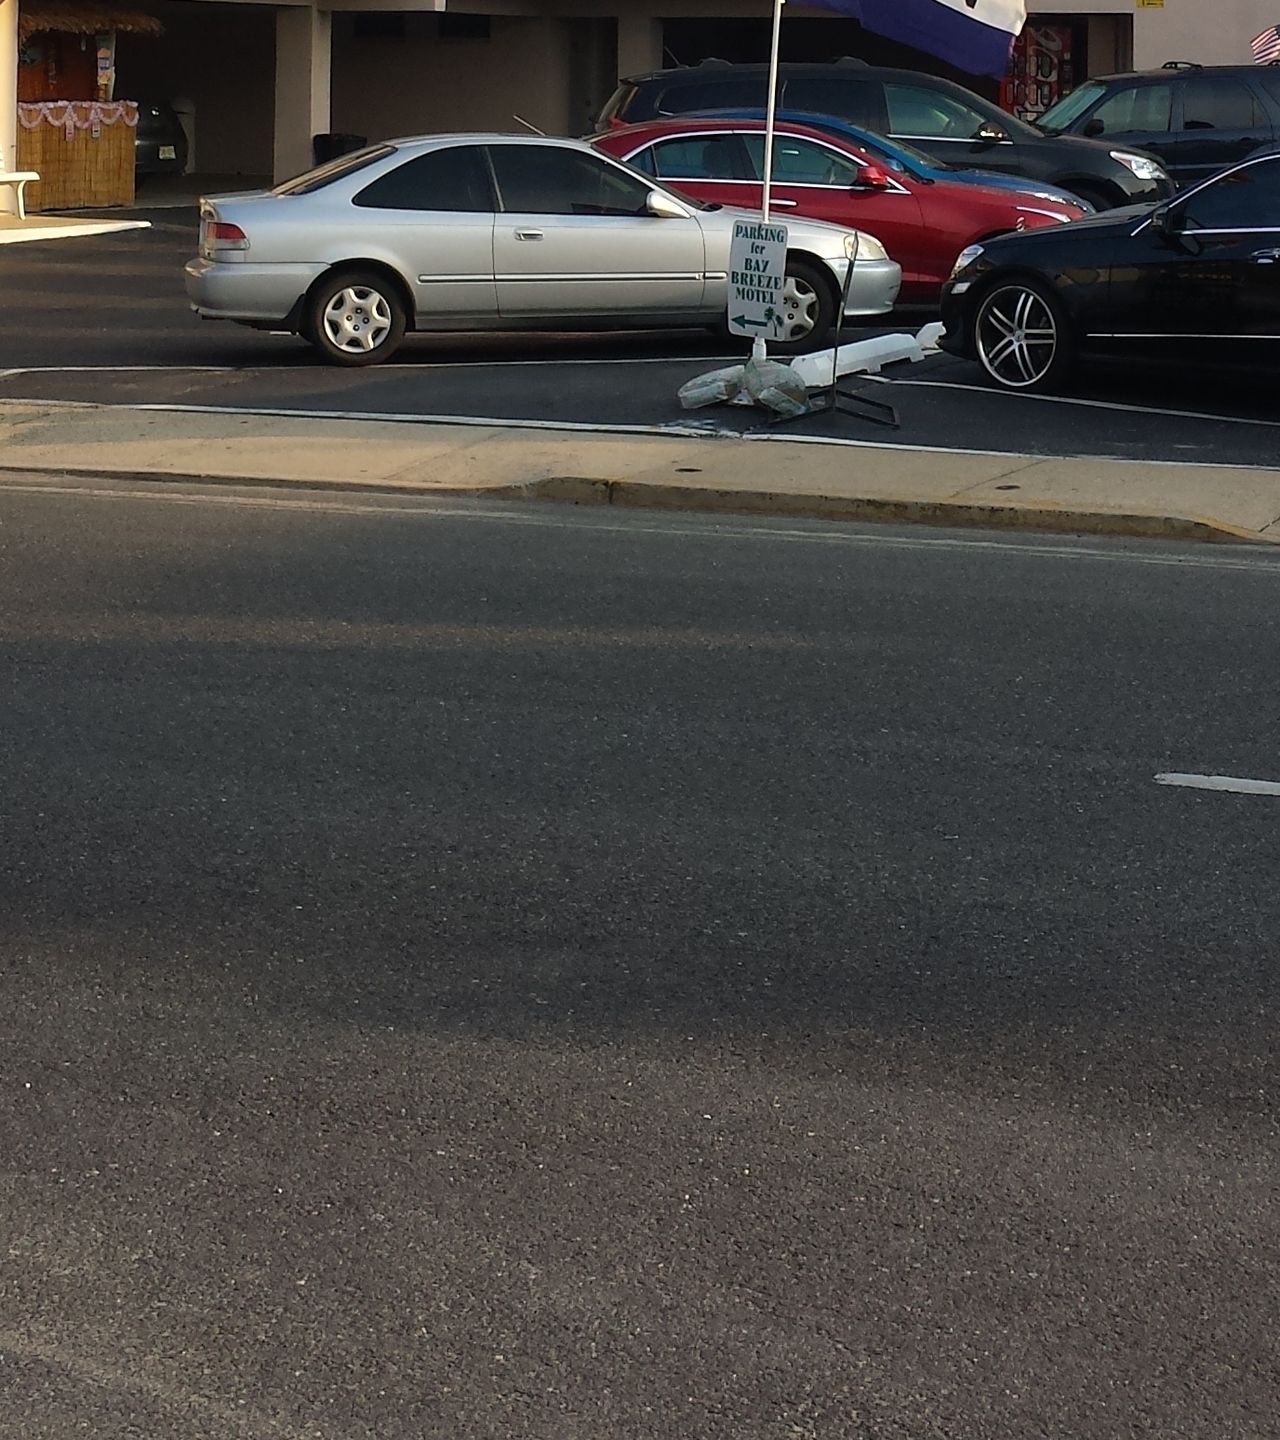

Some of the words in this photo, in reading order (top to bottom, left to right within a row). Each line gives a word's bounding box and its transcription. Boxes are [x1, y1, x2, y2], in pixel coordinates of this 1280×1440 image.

[735, 223, 785, 243] PARKING
[750, 241, 766, 255] for
[744, 257, 769, 273] BAY
[731, 271, 782, 291] BREEZE
[735, 287, 777, 305] MOTEL
